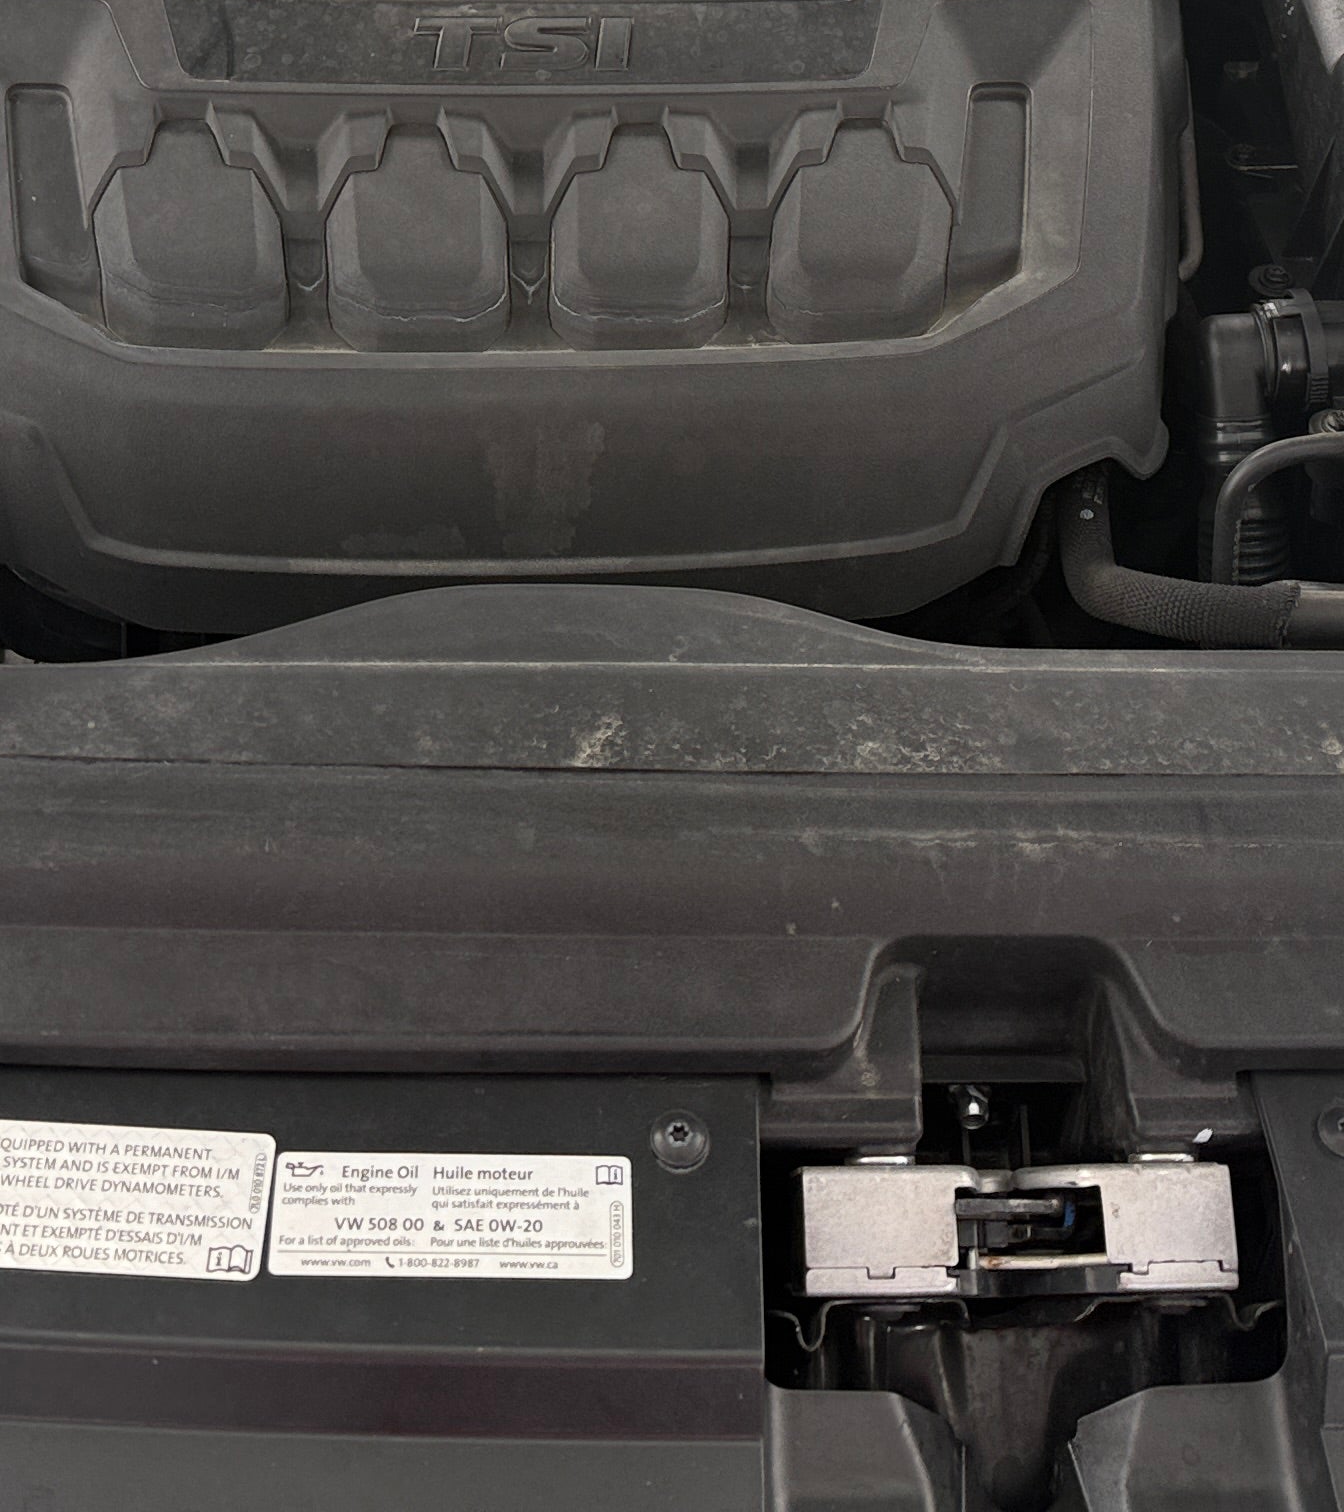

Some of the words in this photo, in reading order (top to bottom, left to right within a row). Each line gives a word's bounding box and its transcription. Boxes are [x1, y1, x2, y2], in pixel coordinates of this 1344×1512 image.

[413, 17, 634, 71] TSI
[68, 1141, 107, 1155] WITH
[110, 1144, 120, 1156] A
[125, 1145, 213, 1160] PERMANENT
[3, 1156, 56, 1170] SYSTEM
[59, 1160, 94, 1173] AND
[97, 1161, 110, 1173] IS
[112, 1162, 170, 1177] EXEMPT
[172, 1166, 213, 1179] FROM
[216, 1167, 240, 1181] I/M
[341, 1165, 393, 1182] Engine
[397, 1165, 419, 1178] Oil
[433, 1167, 473, 1180] Huile
[477, 1169, 533, 1181] moteur
[54, 1177, 98, 1191] DRIVE
[101, 1180, 224, 1199] DYNAMOMETERS.
[283, 1183, 303, 1193] Use
[305, 1183, 327, 1195] only
[331, 1183, 343, 1193] oil
[345, 1183, 366, 1193] that
[368, 1184, 418, 1196] expressly
[432, 1186, 471, 1196] Utilisez
[474, 1187, 539, 1198] uniquement
[542, 1188, 555, 1197] de
[557, 1188, 589, 1197] l'huile
[281, 1196, 328, 1207] complies
[331, 1196, 355, 1206] with
[431, 1199, 449, 1210] qui
[452, 1199, 493, 1209] satisfait
[496, 1200, 570, 1212] expressément
[573, 1201, 579, 1210] à
[23, 1205, 60, 1219] D'UN
[126, 1211, 146, 1224] DE
[149, 1212, 253, 1230] TRANSMISSION
[334, 1217, 364, 1231] VW
[368, 1218, 398, 1231] 508
[403, 1218, 425, 1231] 00
[433, 1220, 444, 1231] &
[455, 1219, 484, 1232] SAE
[489, 1219, 543, 1233] 0W-20
[23, 1224, 38, 1238] ET
[41, 1225, 102, 1239] EXEMPTÉ
[106, 1228, 163, 1245] D'ESSAIS
[279, 1235, 295, 1245] For
[298, 1237, 304, 1245] a
[308, 1235, 323, 1245] list
[326, 1235, 338, 1245] of
[340, 1236, 390, 1247] approved
[393, 1236, 416, 1246] oils:
[430, 1238, 453, 1247] Pour
[456, 1239, 476, 1248] une
[479, 1238, 500, 1248] liste
[503, 1238, 542, 1249] d'huiles
[5, 1242, 15, 1255] À
[19, 1244, 58, 1258] DEUX
[62, 1246, 110, 1261] ROUES
[114, 1248, 186, 1265] MOTRICES.
[301, 1258, 371, 1267] www.vw.com
[499, 1260, 558, 1269] www.vw.ca
